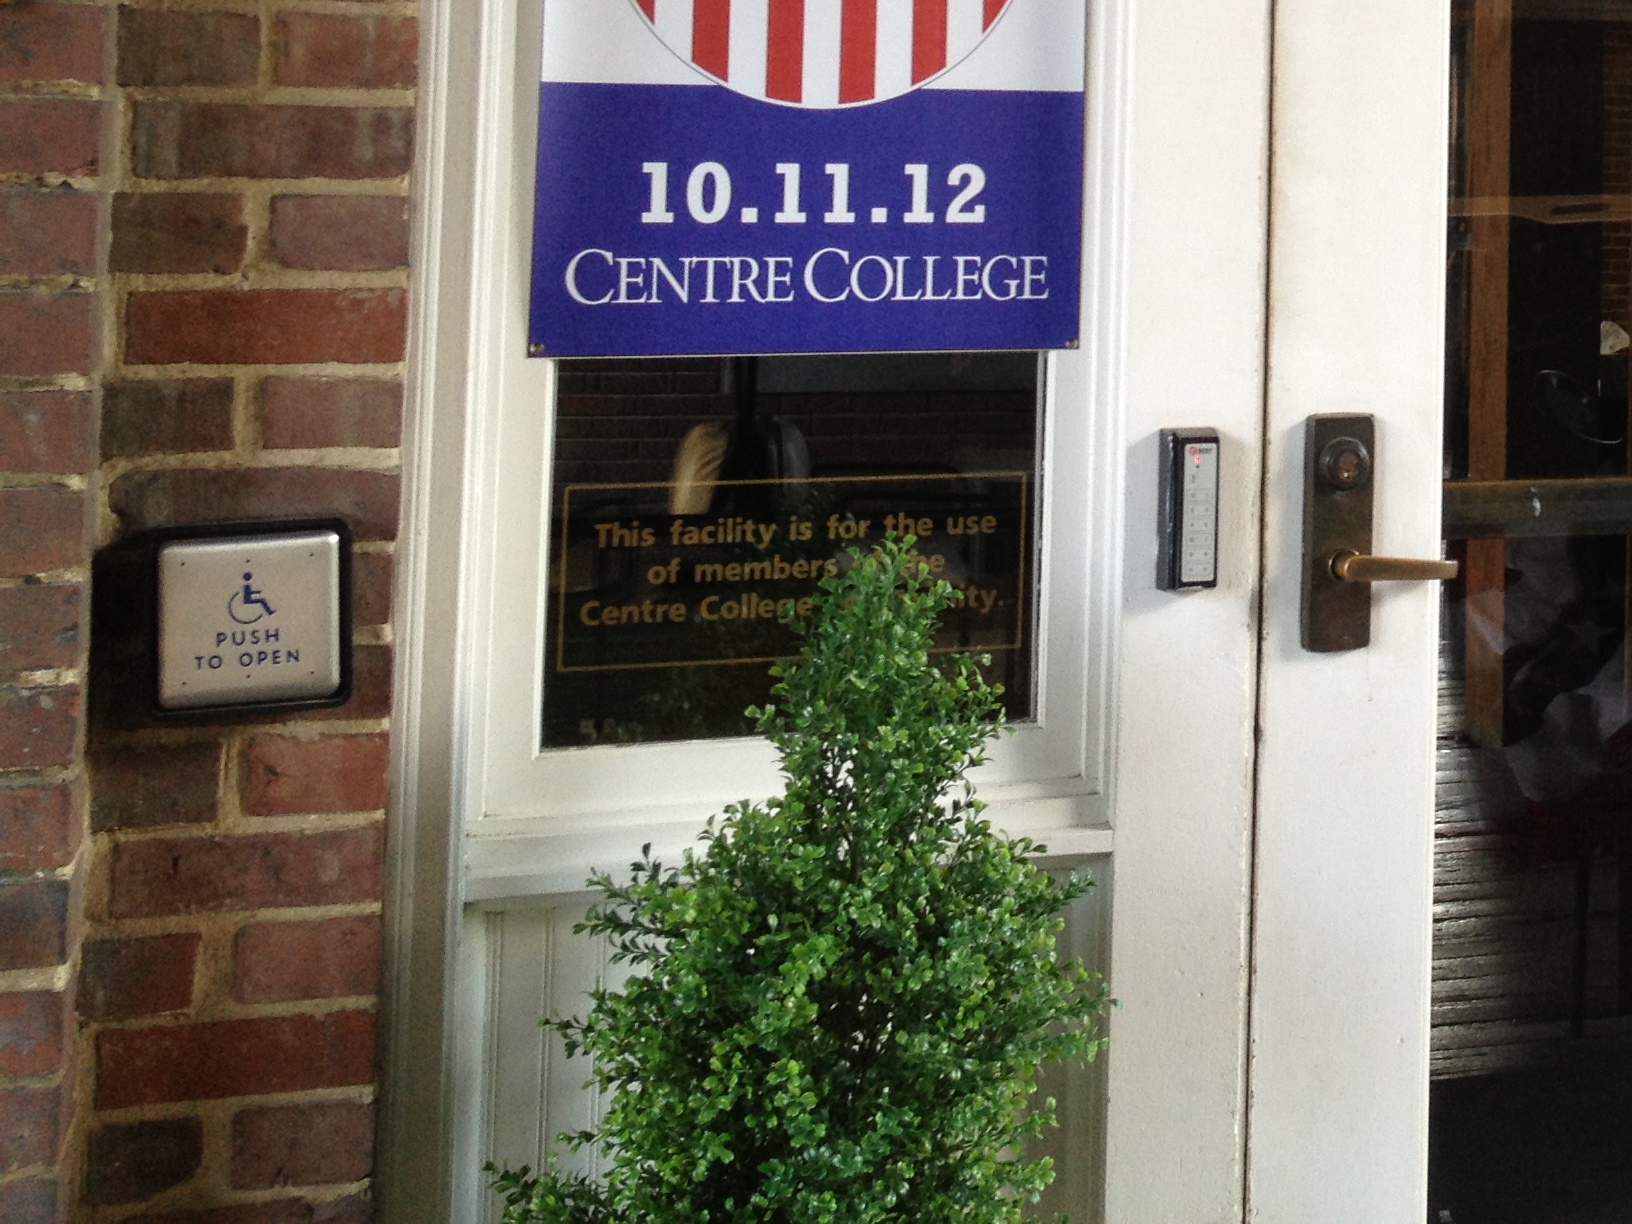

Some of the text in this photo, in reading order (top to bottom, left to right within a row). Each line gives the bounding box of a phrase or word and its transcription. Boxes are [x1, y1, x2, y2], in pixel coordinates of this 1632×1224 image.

[640, 161, 986, 224] 10.11.12
[564, 247, 1049, 305] CENTRE COLLEGE
[595, 511, 998, 550] This facility is for the use
[647, 556, 681, 585] of
[693, 553, 839, 583] members
[579, 599, 687, 626] Centre
[700, 592, 814, 624] College
[216, 628, 280, 648] PUSH
[195, 648, 301, 670] TO OPEN
